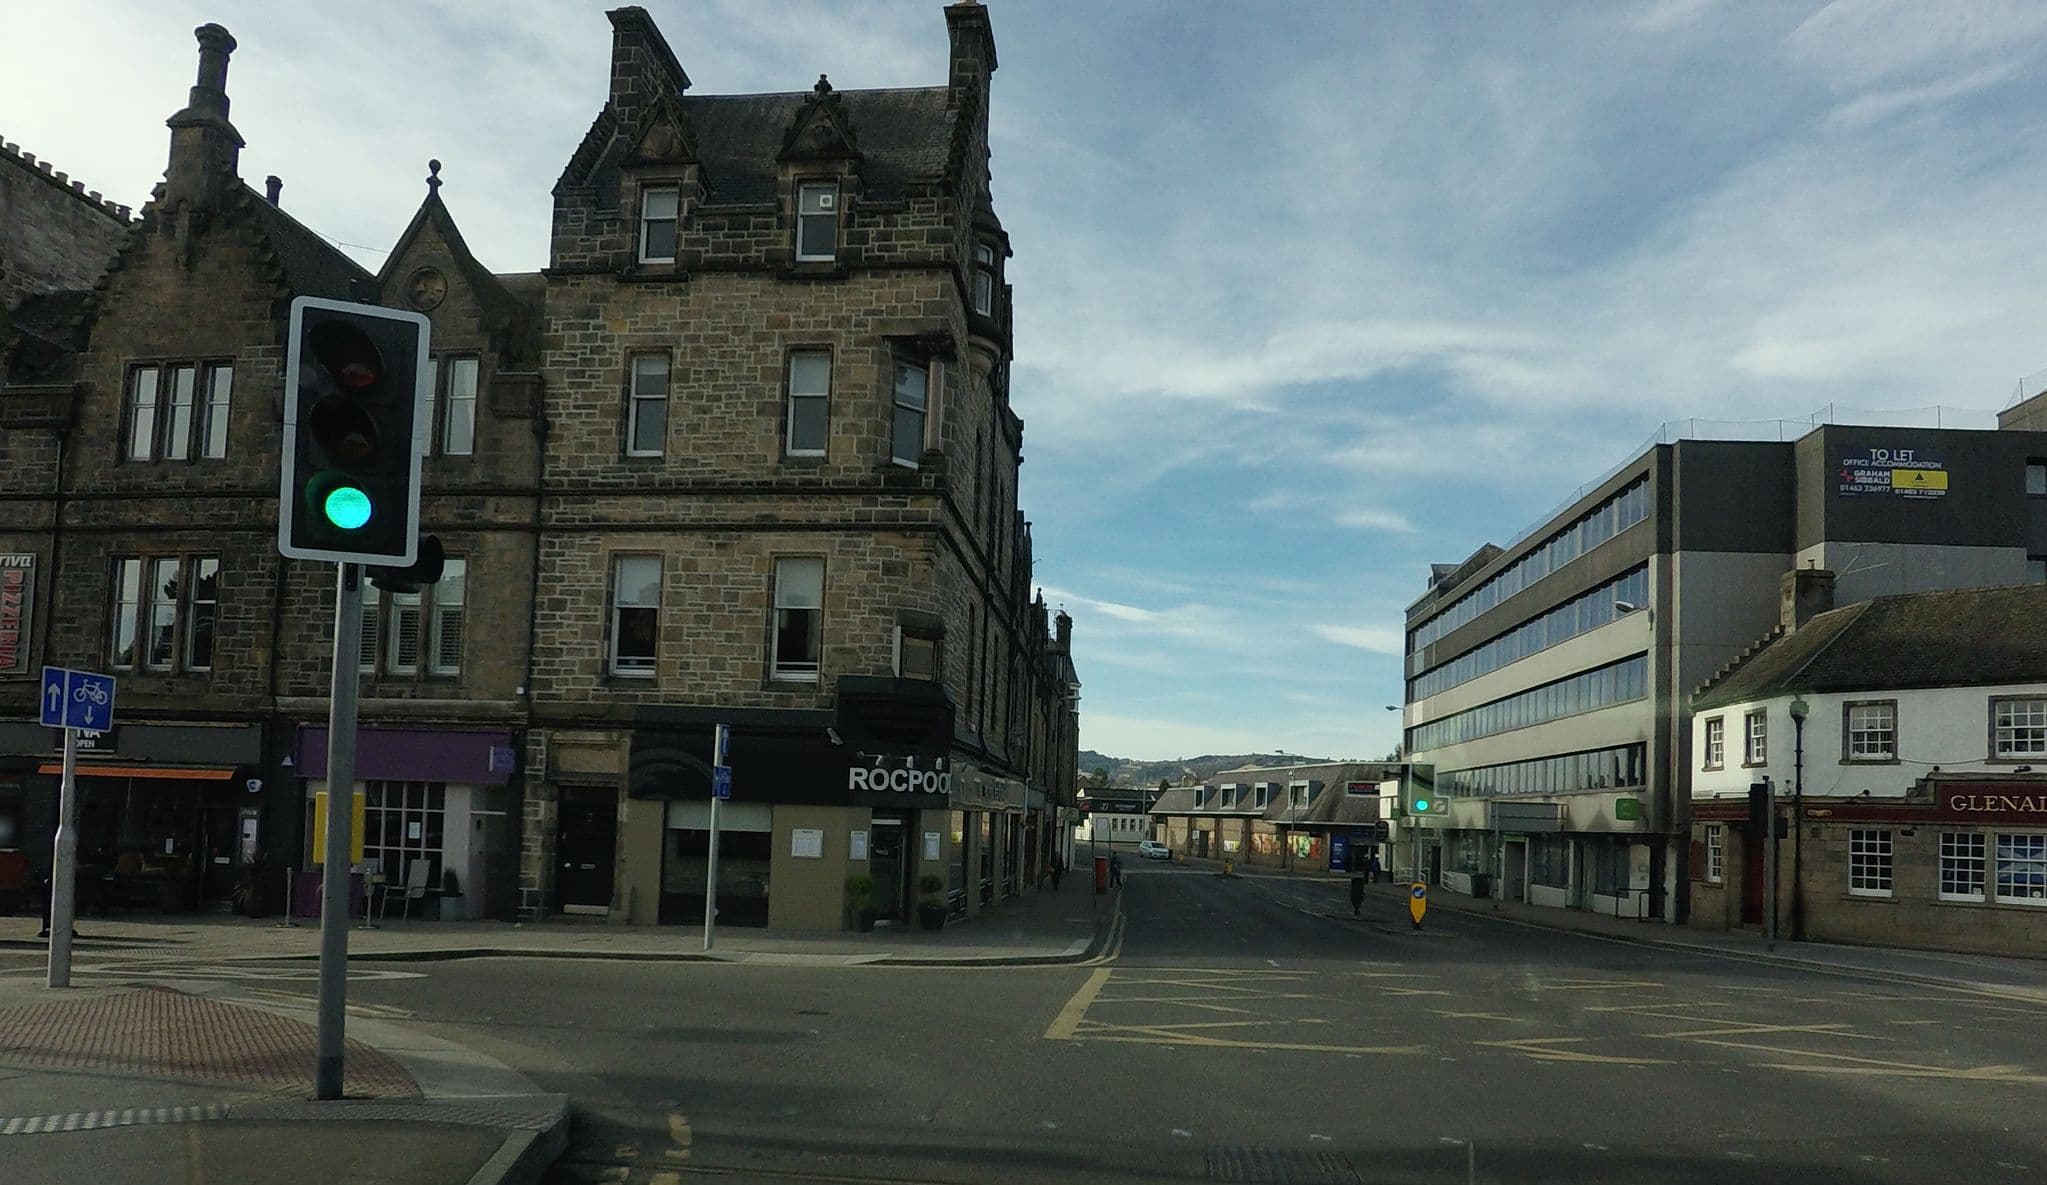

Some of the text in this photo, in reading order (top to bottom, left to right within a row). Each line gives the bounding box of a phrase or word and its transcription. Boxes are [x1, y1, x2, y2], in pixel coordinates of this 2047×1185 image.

[1870, 449, 1914, 462] TO LET
[1871, 460, 1942, 469] ACCOMMODATION
[0, 569, 24, 670] PIZZERIA
